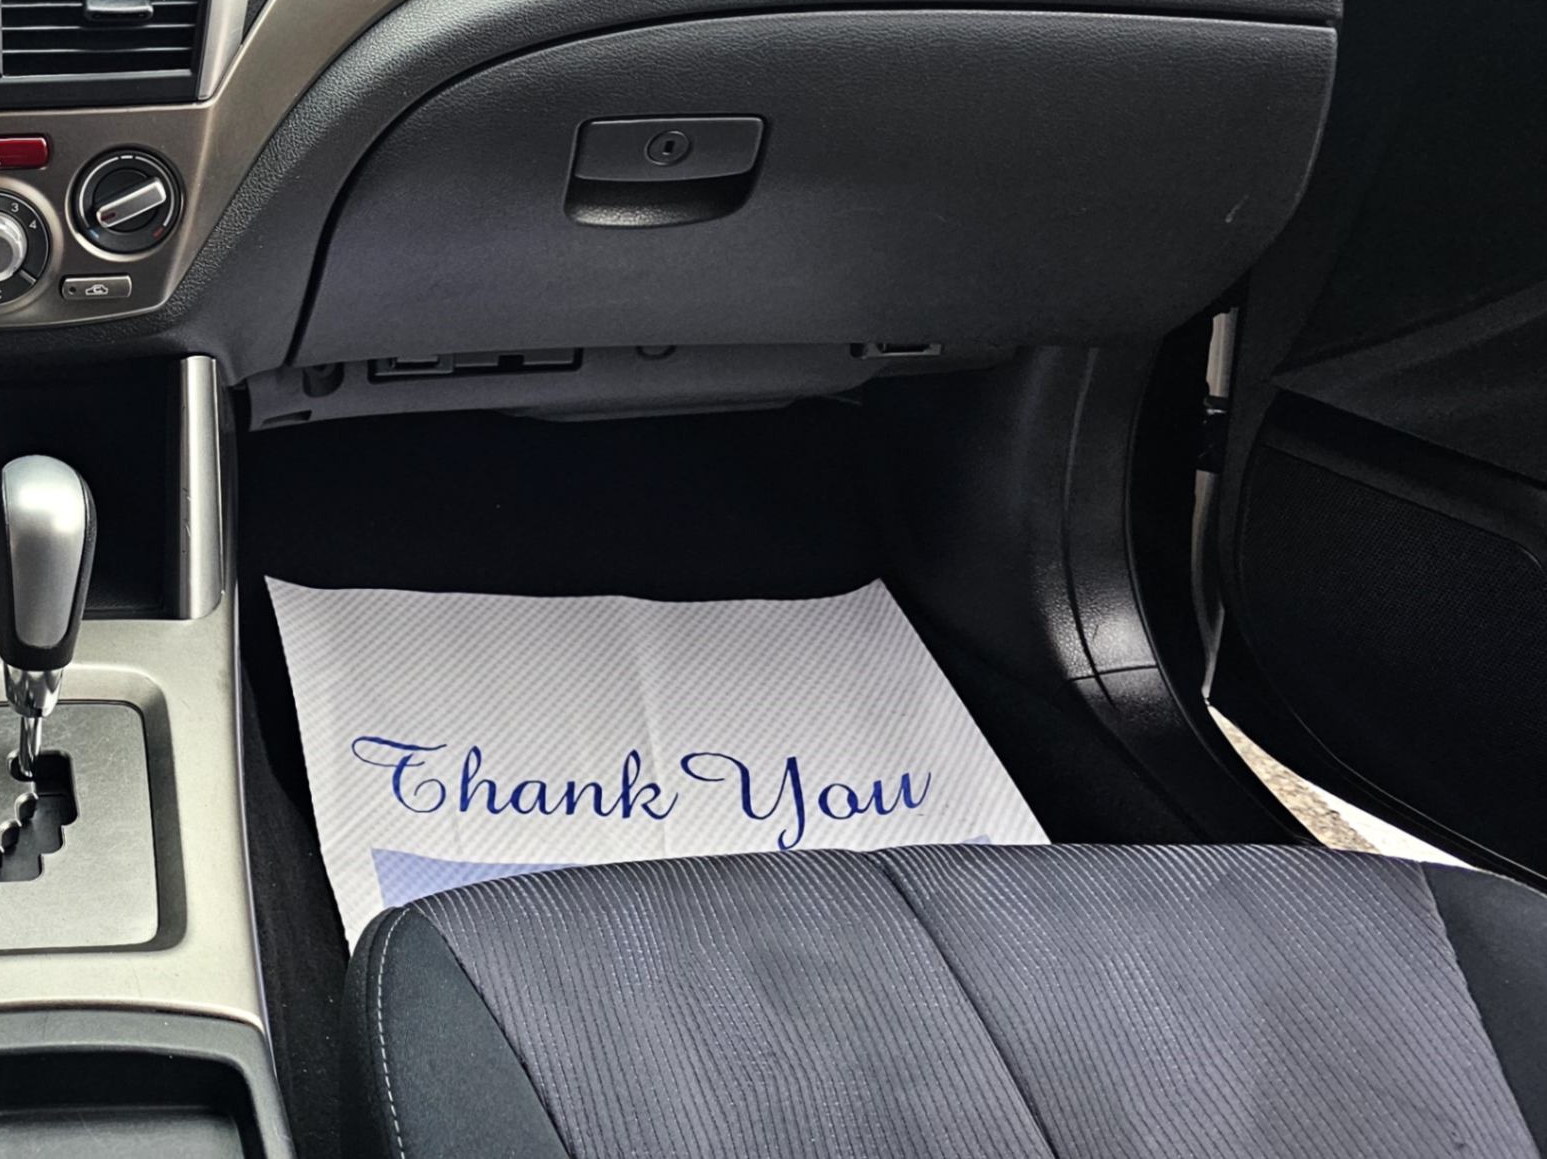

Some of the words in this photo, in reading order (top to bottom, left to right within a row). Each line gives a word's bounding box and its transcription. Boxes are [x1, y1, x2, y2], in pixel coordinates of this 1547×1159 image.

[11, 203, 19, 212] 3
[29, 220, 37, 229] 4
[351, 736, 679, 820] Thank
[679, 752, 932, 852] You
